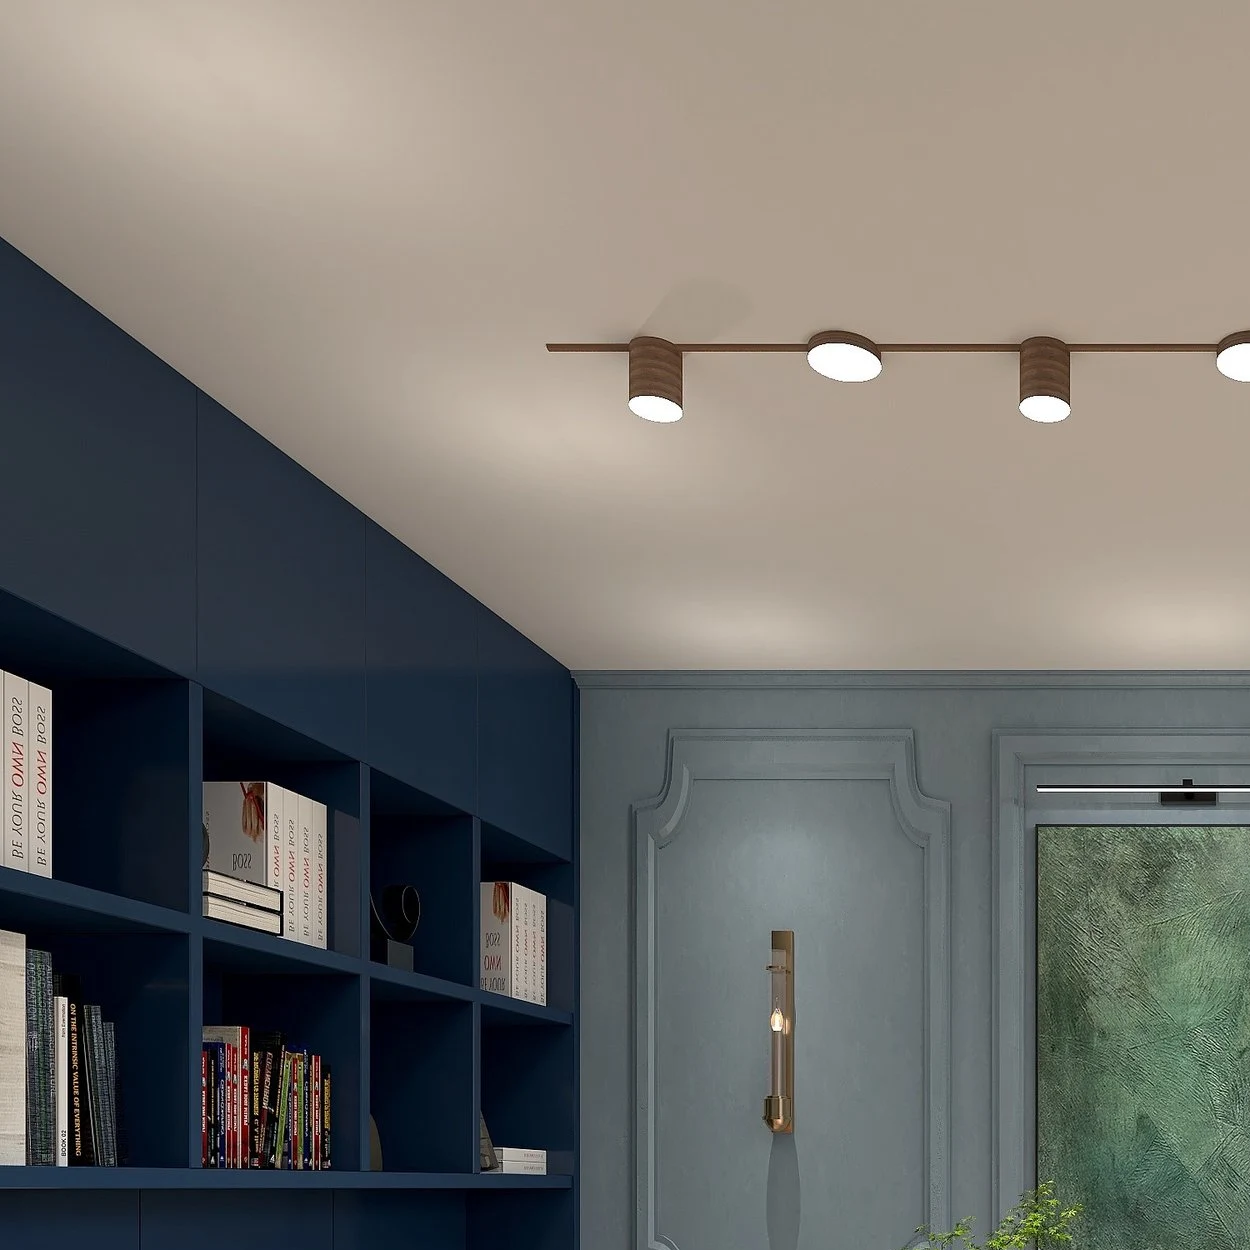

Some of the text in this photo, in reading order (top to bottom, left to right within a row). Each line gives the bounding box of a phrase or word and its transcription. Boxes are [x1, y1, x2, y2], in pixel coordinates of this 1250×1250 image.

[27, 962, 37, 1019] OCCUPATION
[70, 1003, 76, 1015] ON
[71, 1033, 79, 1069] INTRINSIC
[73, 1097, 80, 1108] OF
[61, 1130, 66, 1138] 02
[73, 1108, 81, 1156] EVERYTHING
